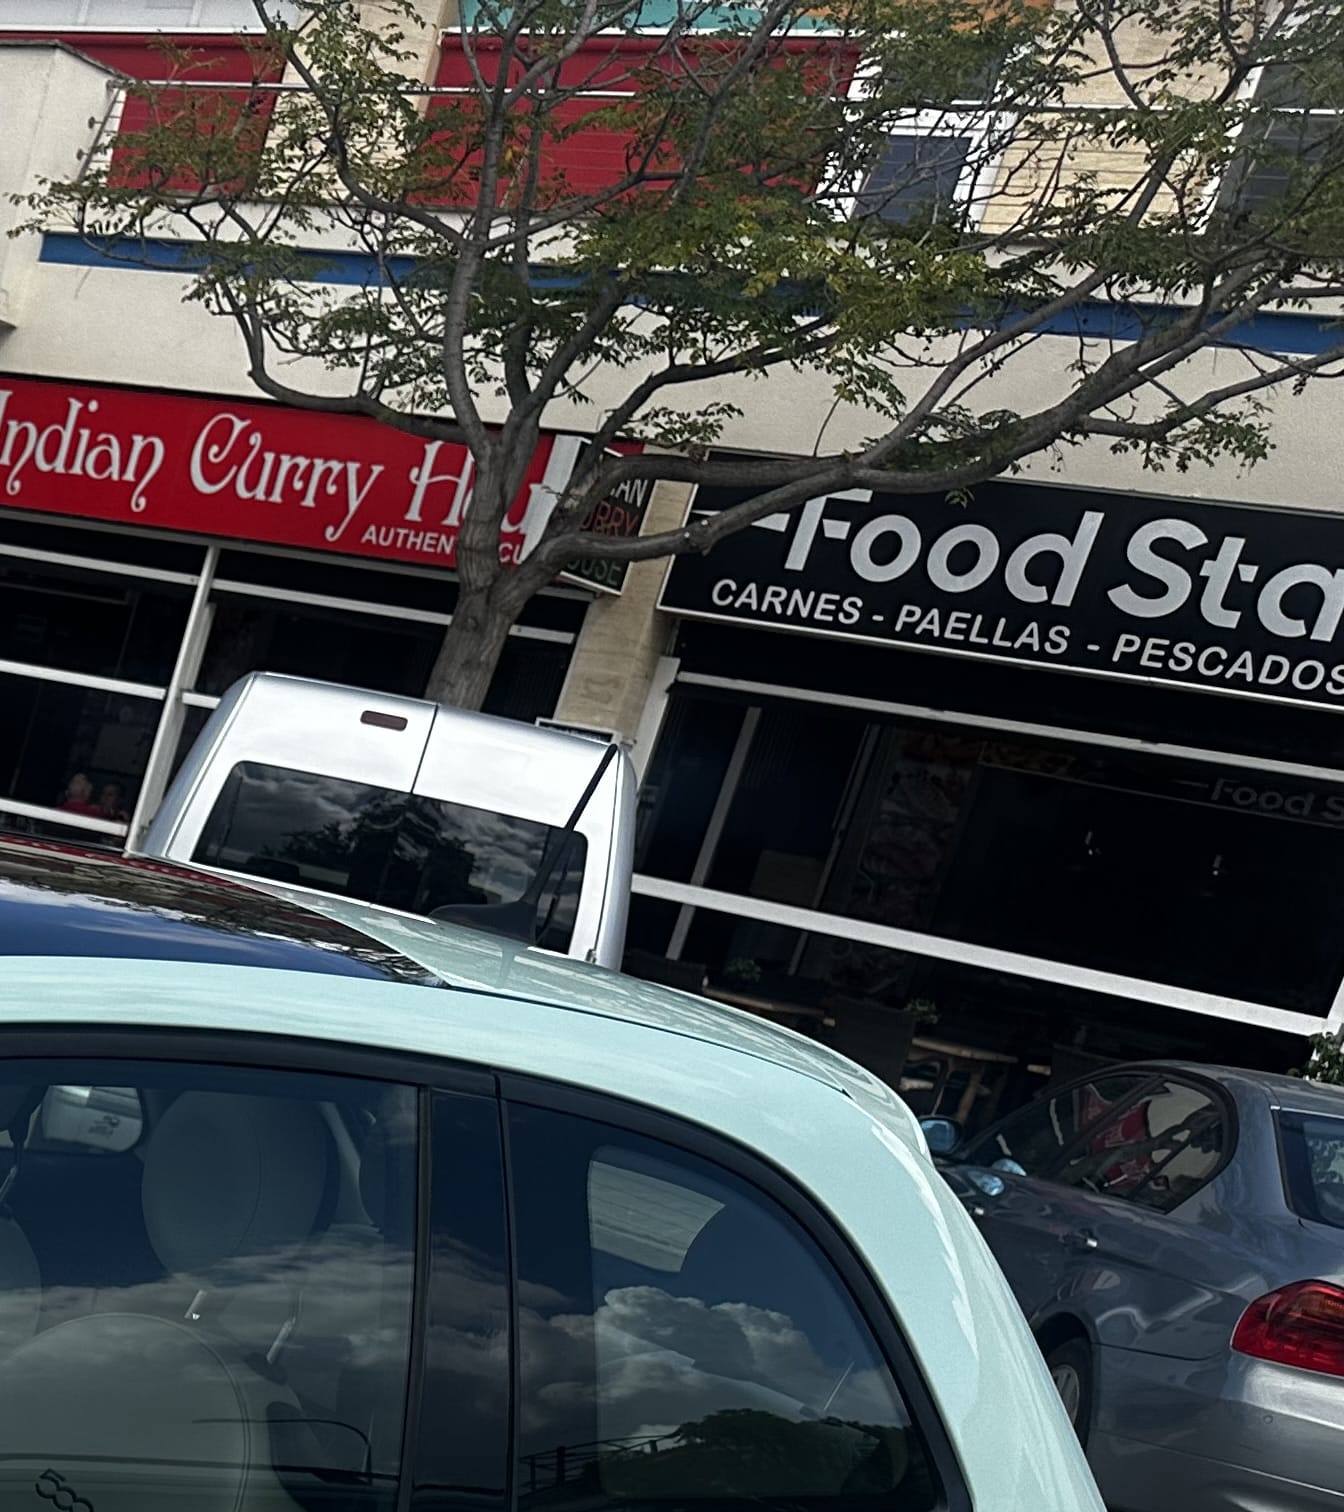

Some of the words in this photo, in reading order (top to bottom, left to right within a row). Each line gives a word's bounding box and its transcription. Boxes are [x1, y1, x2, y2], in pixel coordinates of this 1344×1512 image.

[189, 413, 384, 541] Curry
[784, 486, 1105, 608] Food
[712, 579, 862, 625] CARNES
[895, 605, 1071, 655] PAELLAS
[1112, 634, 1344, 695] PESCADOS
